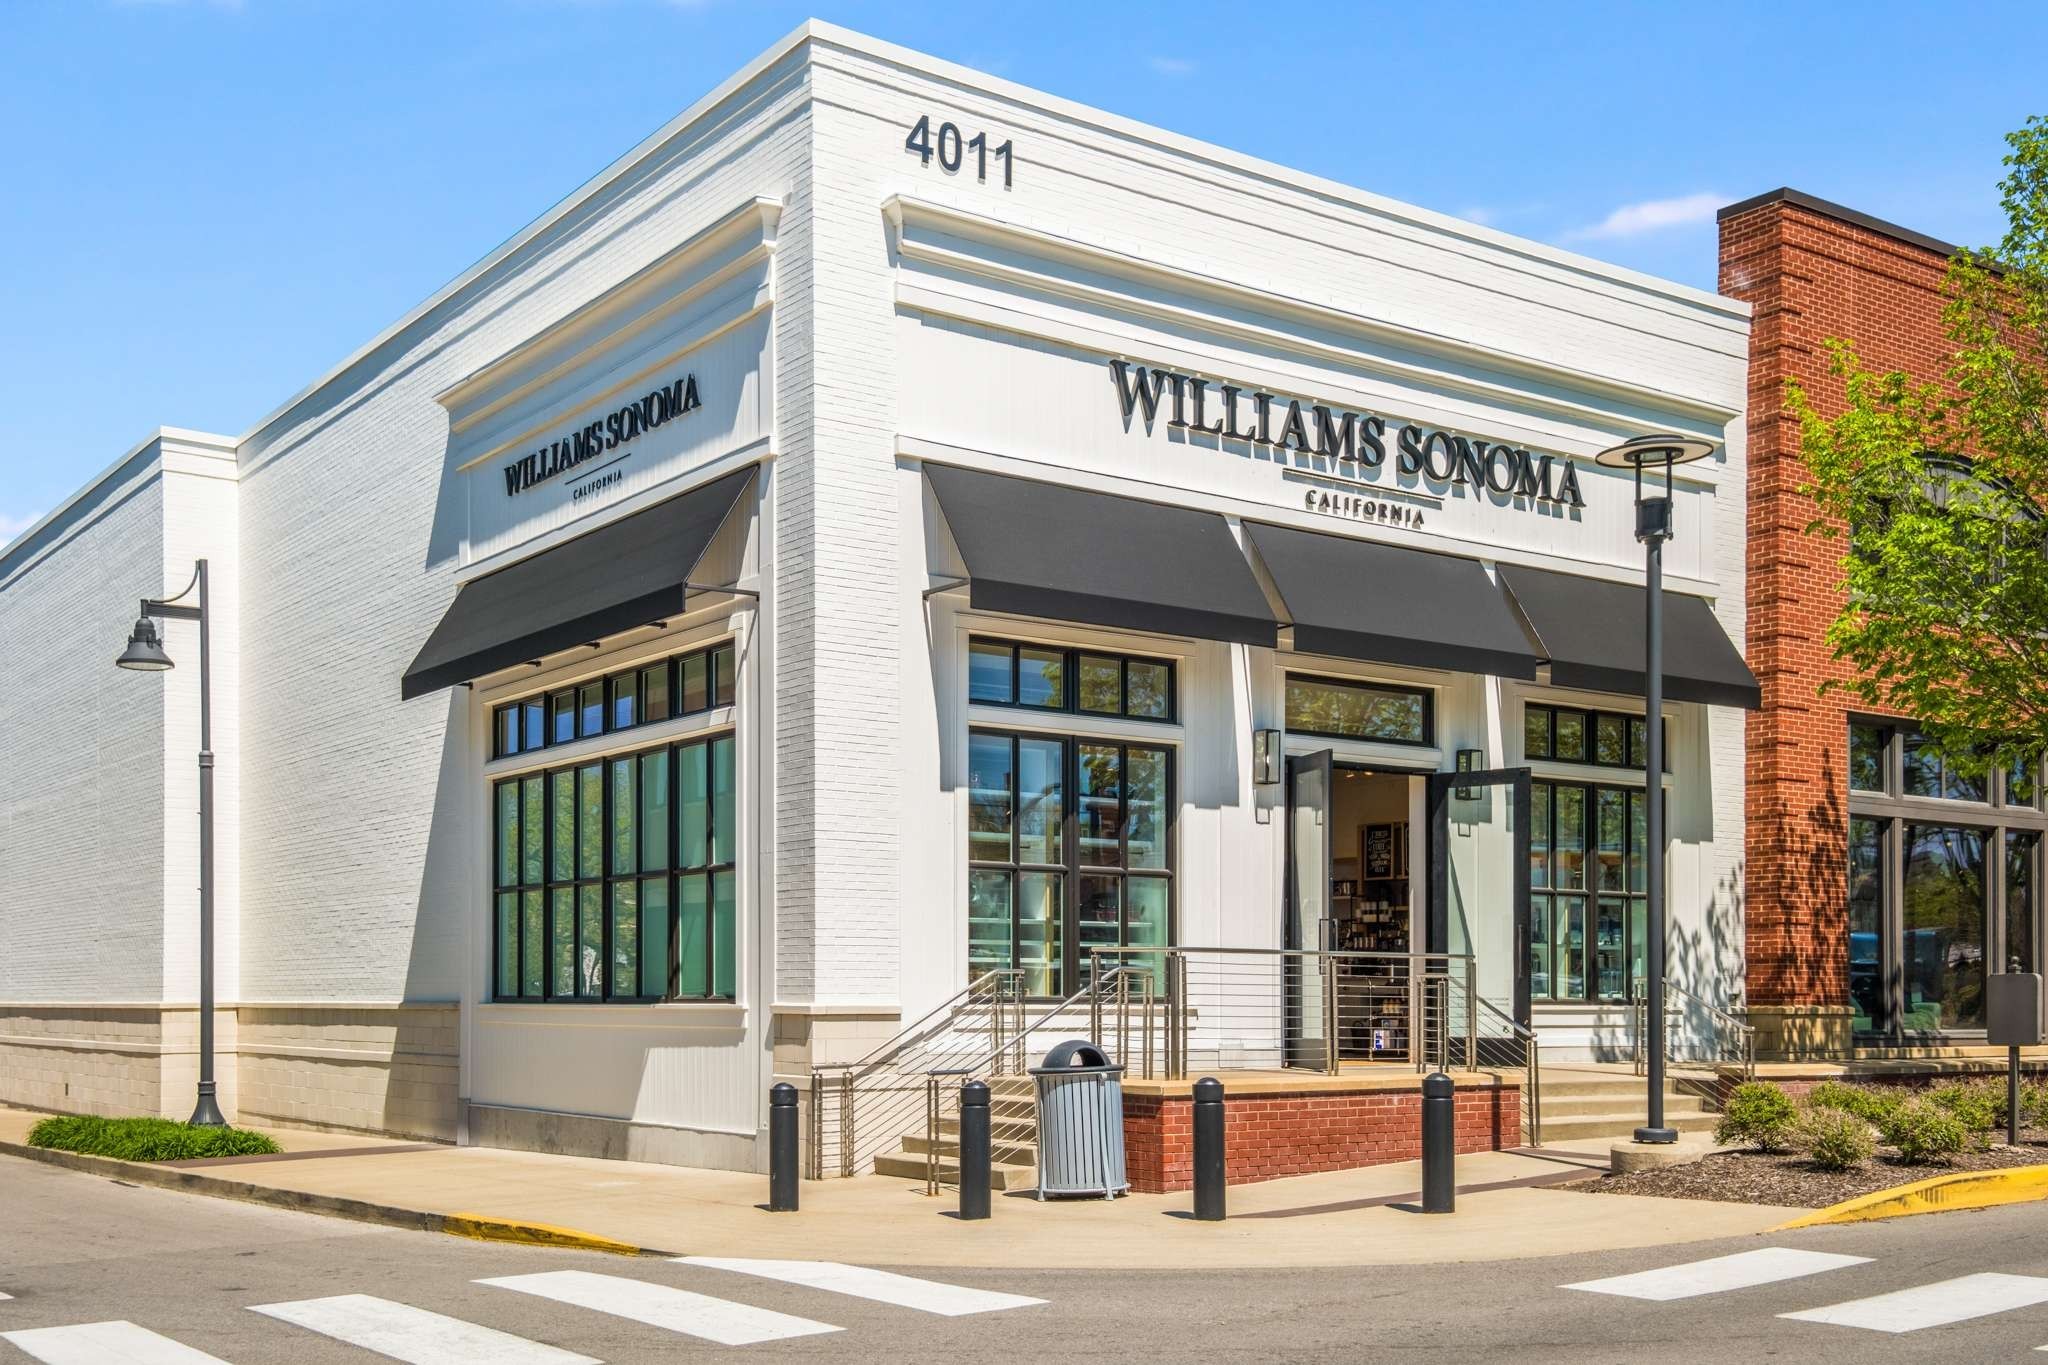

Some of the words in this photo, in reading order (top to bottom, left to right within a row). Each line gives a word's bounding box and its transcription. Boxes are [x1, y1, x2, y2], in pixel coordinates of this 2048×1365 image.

[905, 115, 1013, 188] 4011
[504, 420, 604, 497] WILLIAMS
[605, 373, 702, 450] SONOMA
[1109, 359, 1385, 467] WILLIAMS
[1396, 424, 1586, 508] SONOMA
[573, 469, 623, 500] CALIFORNIA
[1305, 489, 1424, 526] CALIFORNIA
